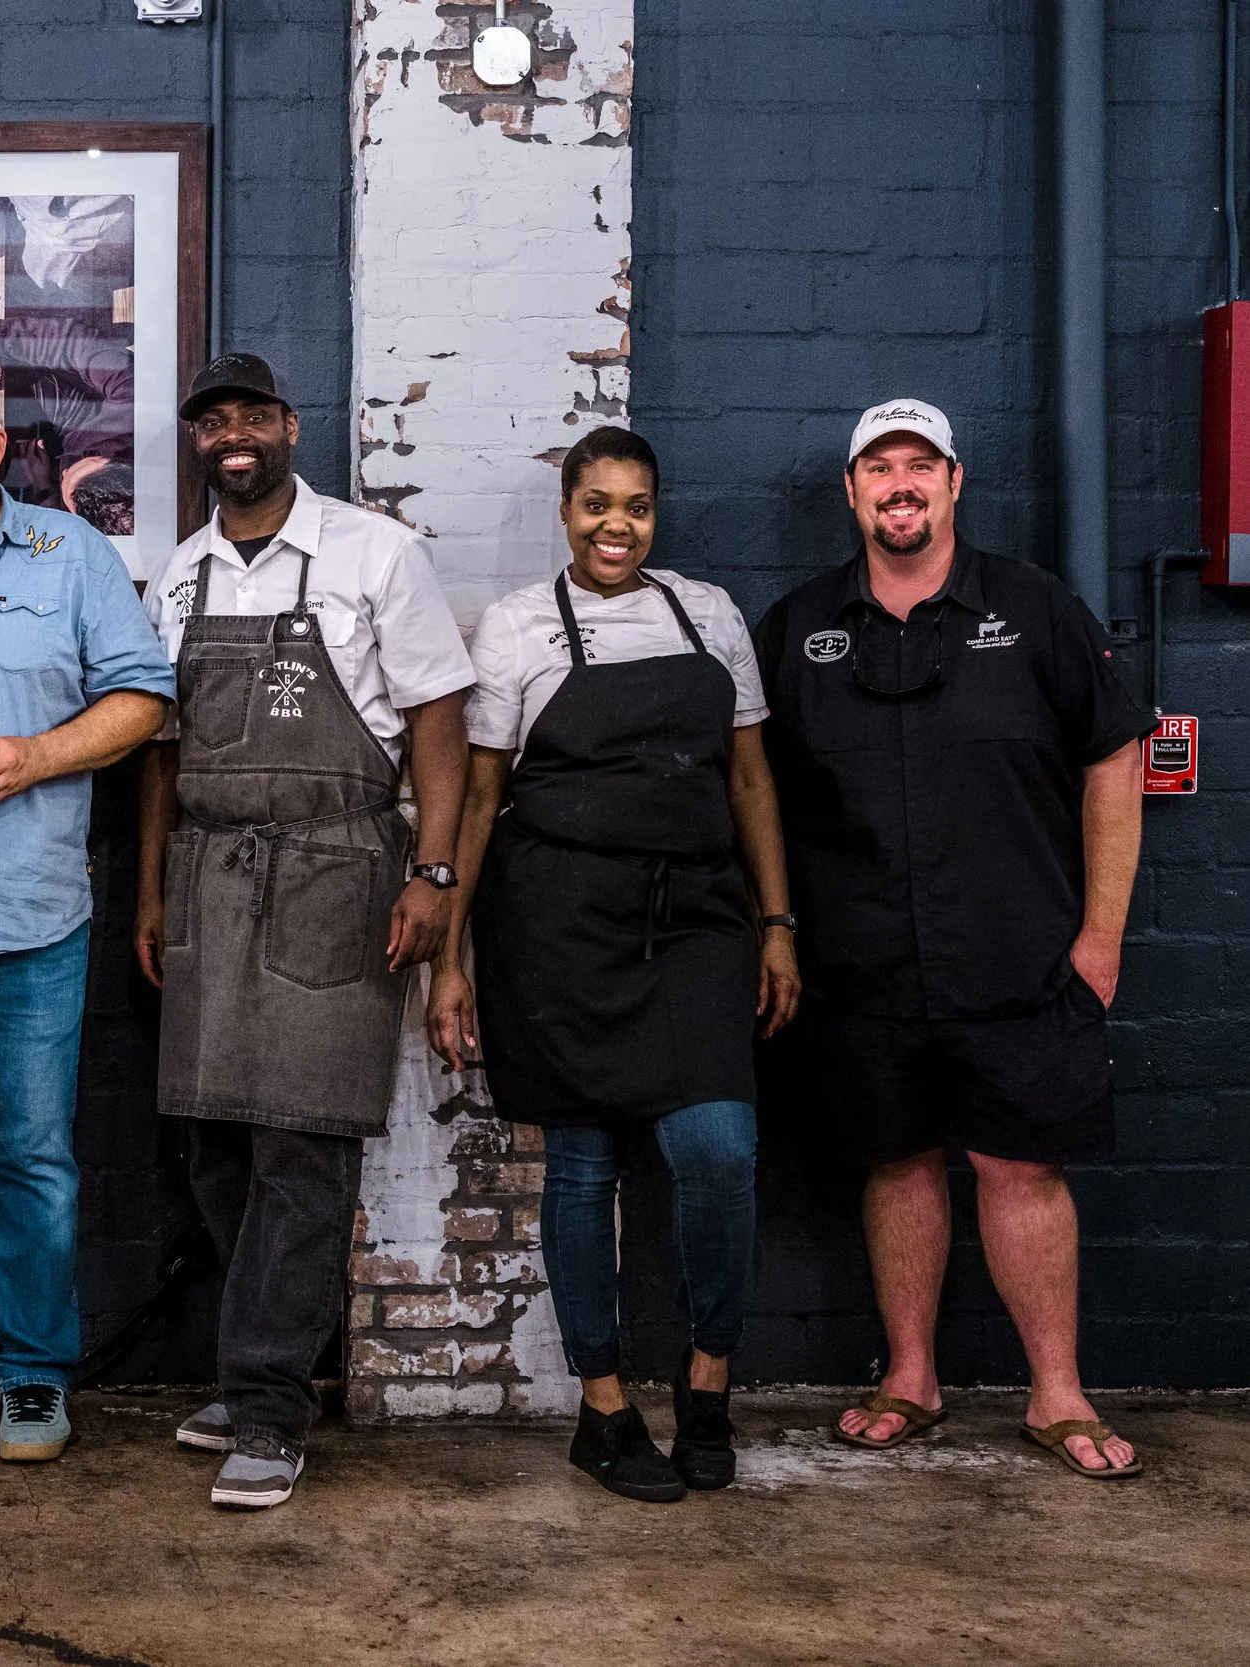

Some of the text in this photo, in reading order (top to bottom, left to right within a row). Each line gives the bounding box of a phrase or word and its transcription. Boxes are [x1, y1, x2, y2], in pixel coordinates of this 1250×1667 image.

[305, 600, 325, 610] Greg
[270, 707, 303, 718] BBQ
[1162, 720, 1192, 736] IRE
